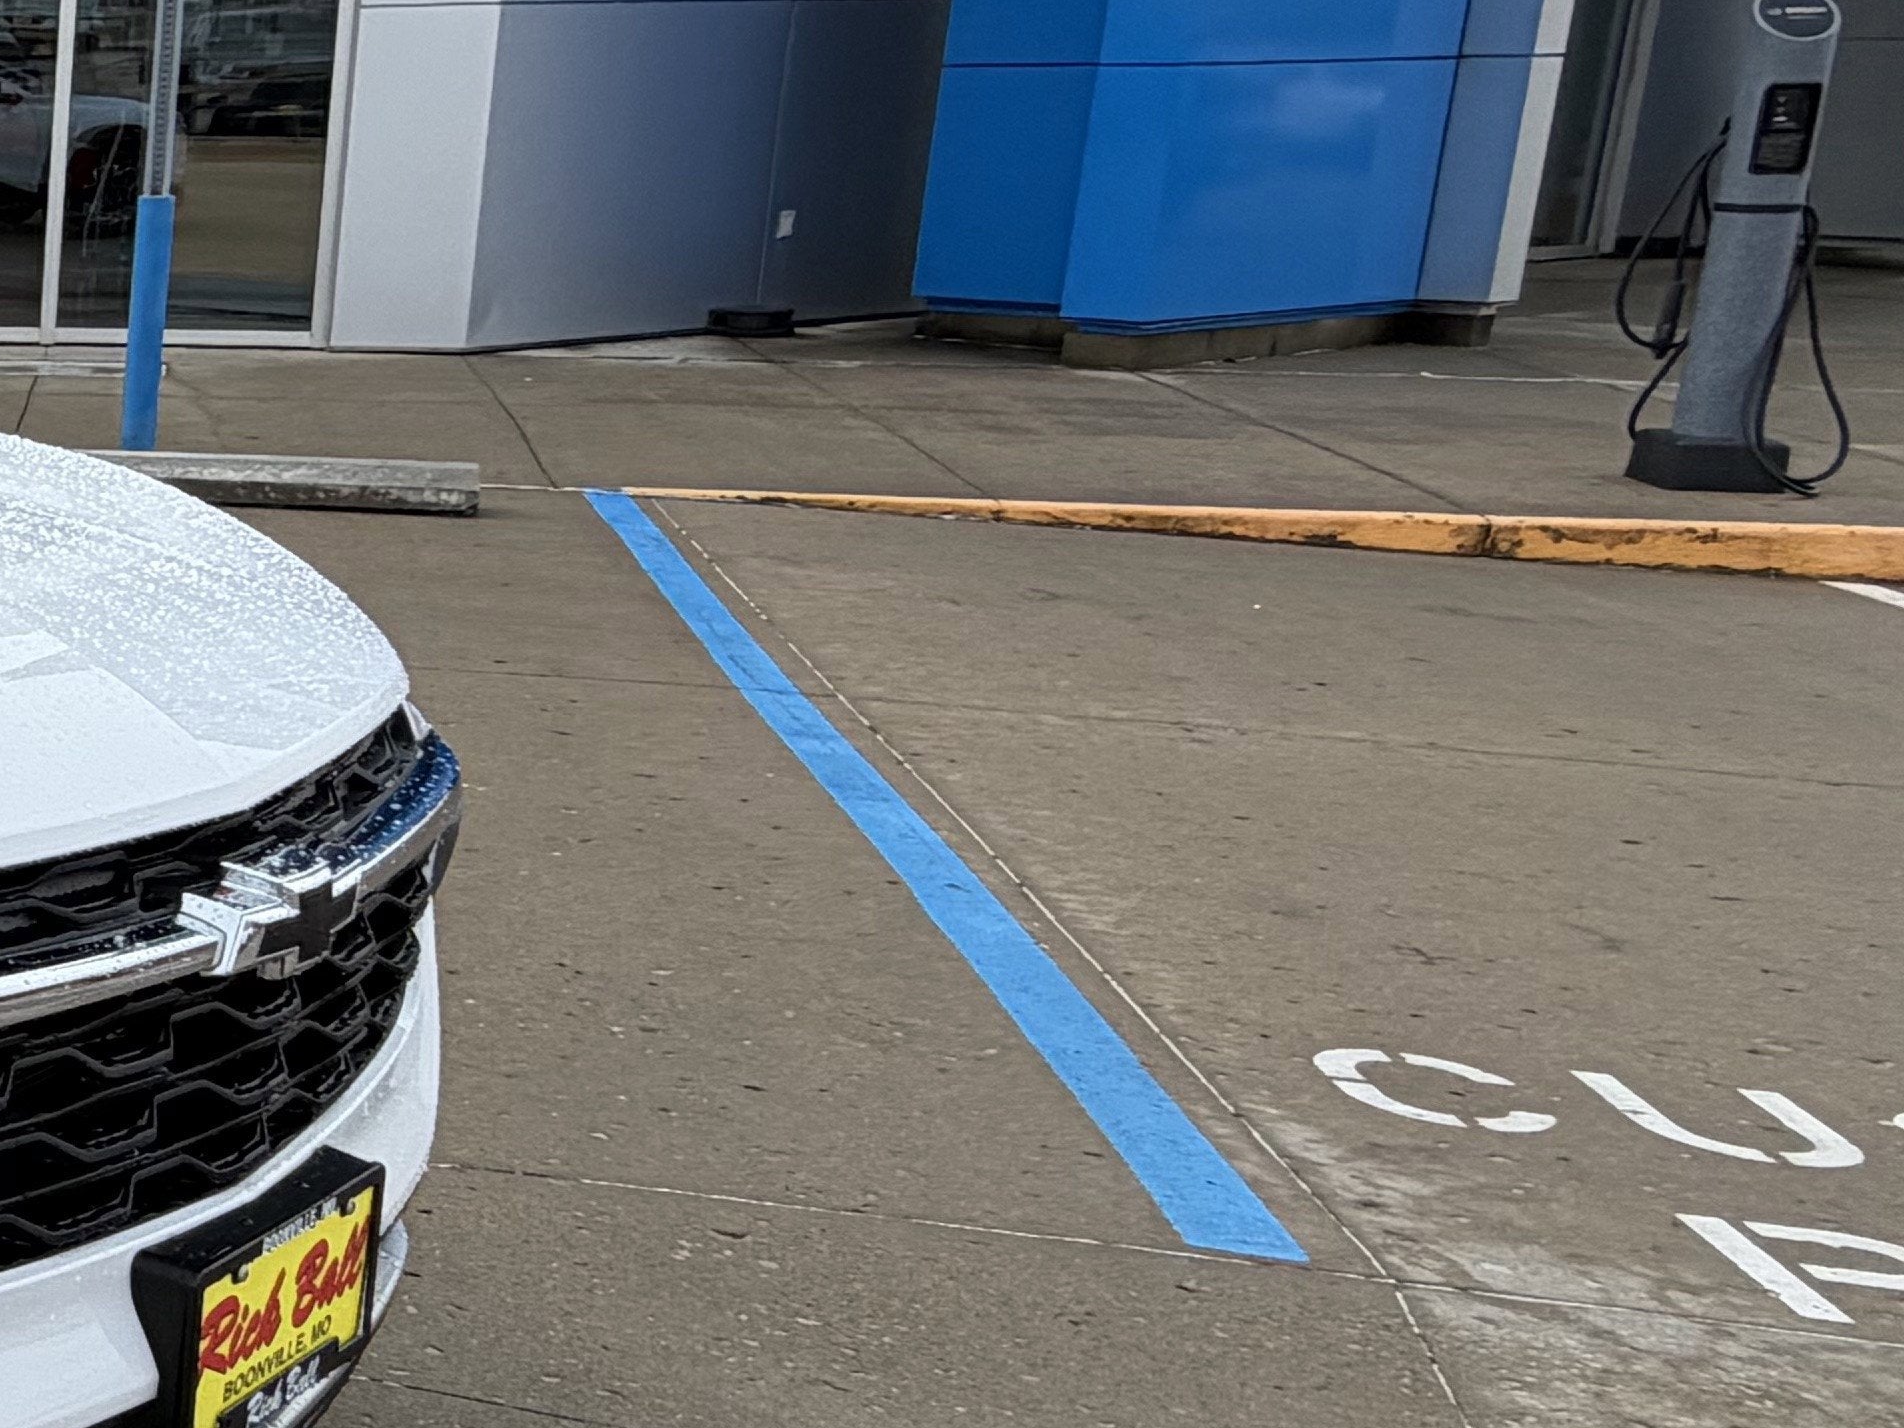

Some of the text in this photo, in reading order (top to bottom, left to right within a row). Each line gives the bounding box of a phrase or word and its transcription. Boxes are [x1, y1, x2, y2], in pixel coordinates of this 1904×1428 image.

[1312, 1048, 1904, 1168] CU
[199, 1212, 370, 1375] Rick Ball
[310, 1314, 332, 1344] MO
